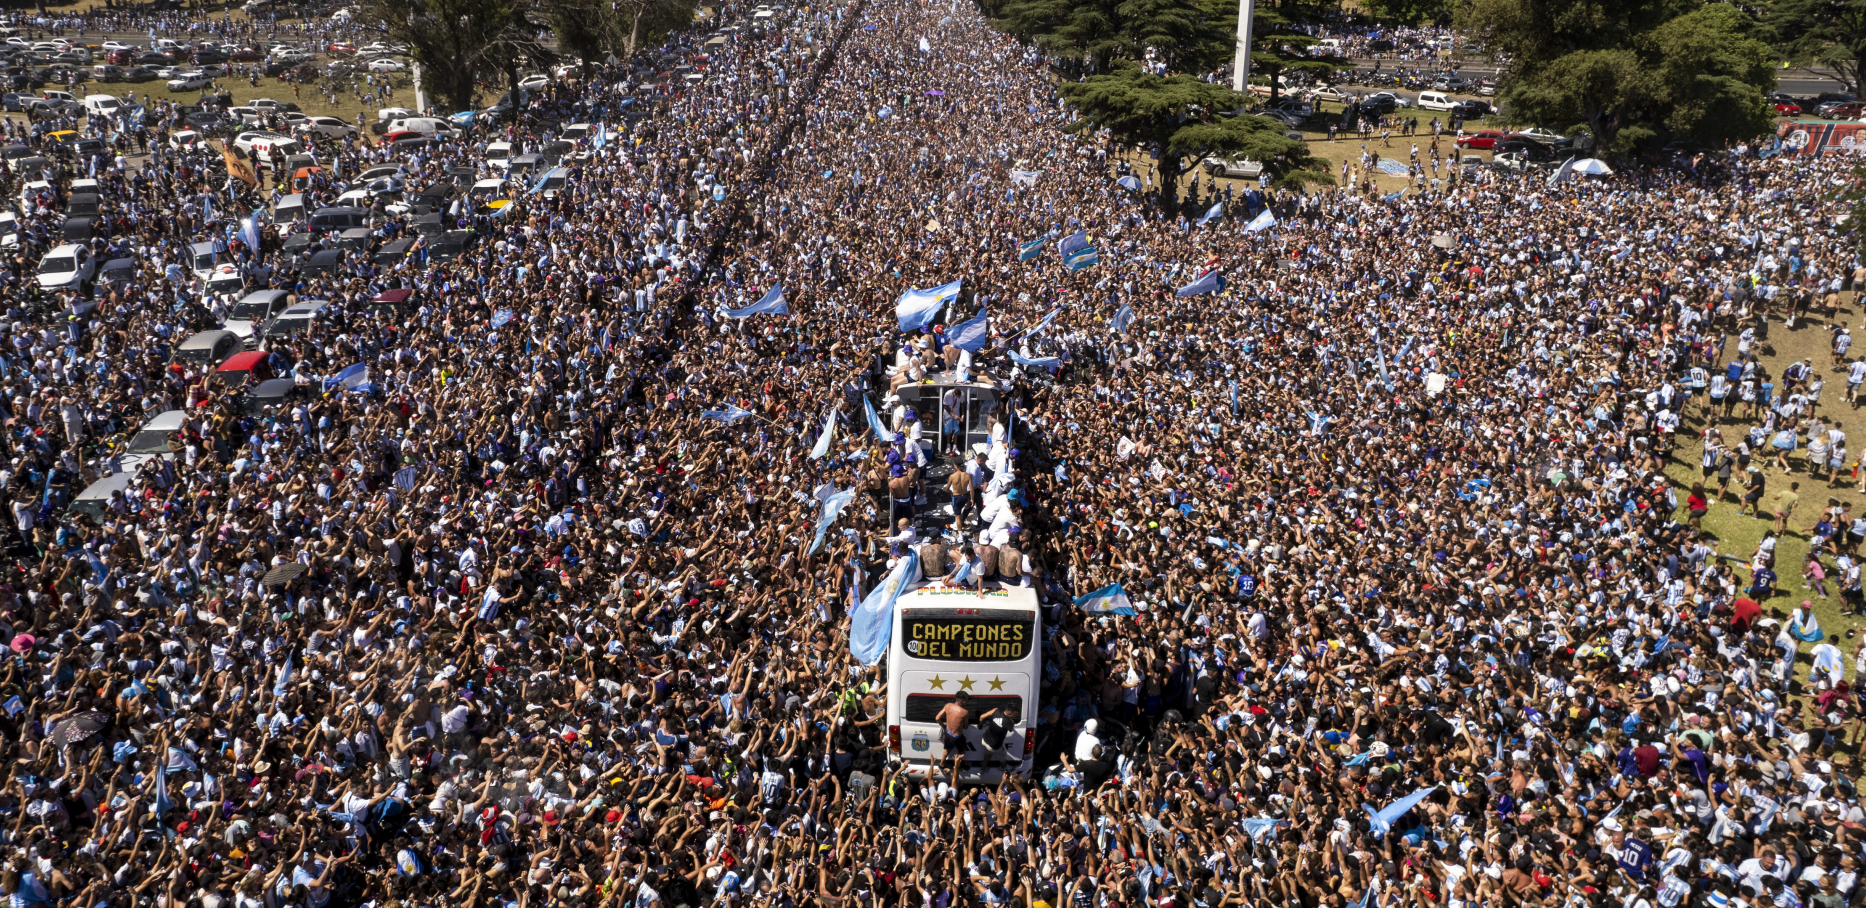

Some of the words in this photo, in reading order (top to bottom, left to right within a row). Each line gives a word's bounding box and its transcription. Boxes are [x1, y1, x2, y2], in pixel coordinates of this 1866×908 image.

[1692, 372, 1702, 381] 10
[404, 474, 408, 484] 7
[1243, 580, 1254, 590] 10
[1760, 578, 1767, 587] 9
[912, 623, 1024, 641] CAMPEONES
[916, 641, 952, 658] DEL
[959, 642, 1022, 658] MUNDO
[764, 782, 777, 797] 10
[1623, 848, 1639, 867] 10
[1664, 887, 1678, 901] 10
